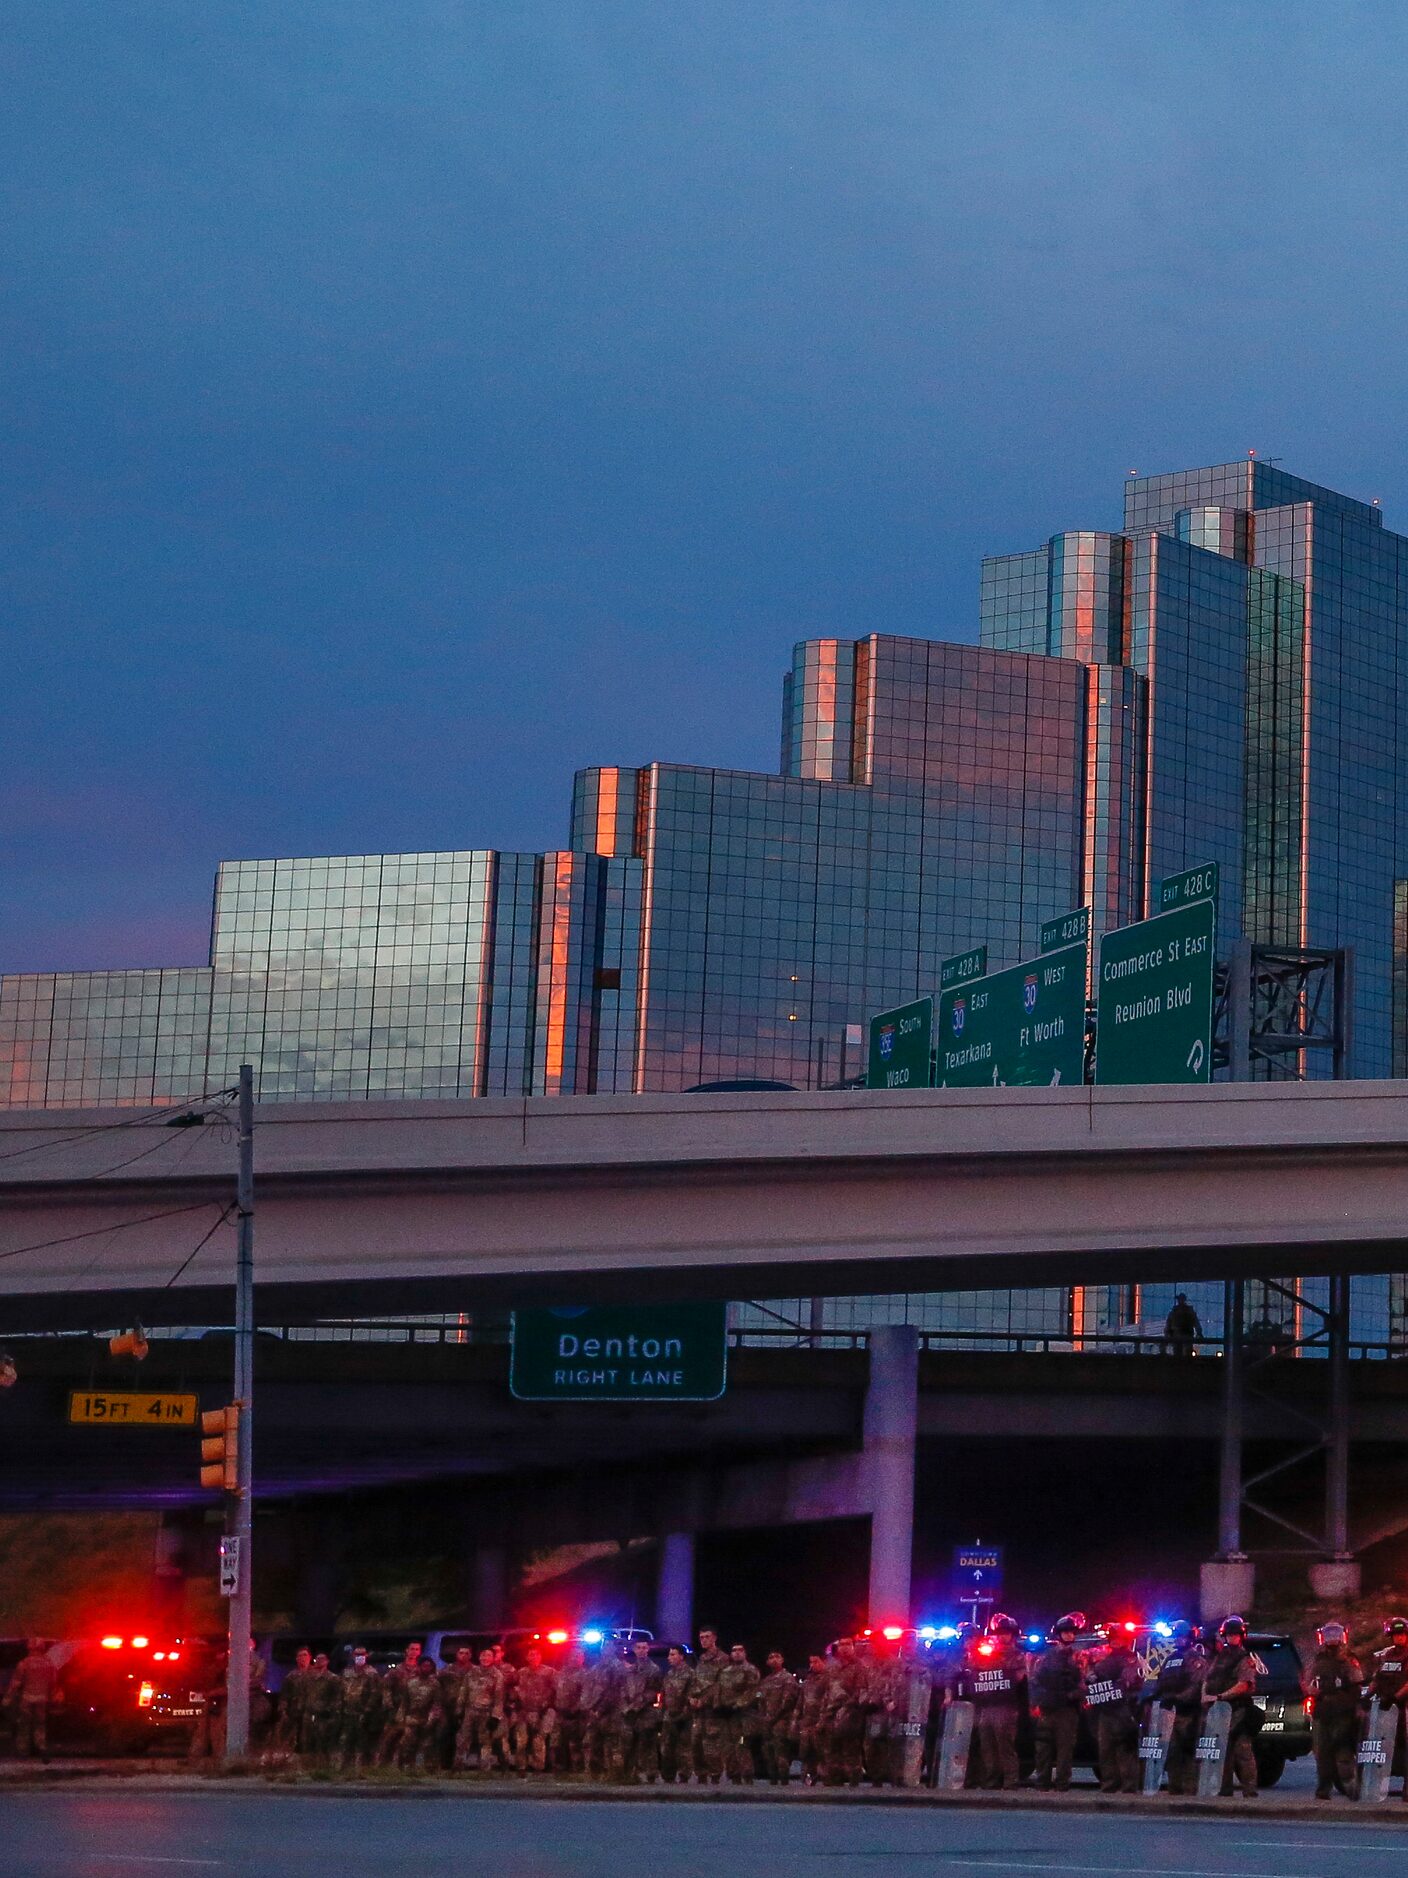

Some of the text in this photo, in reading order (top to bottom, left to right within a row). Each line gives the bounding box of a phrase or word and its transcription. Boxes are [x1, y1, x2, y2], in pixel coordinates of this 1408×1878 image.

[1164, 885, 1178, 902] EXIT
[1044, 929, 1056, 944] EXIT
[1104, 949, 1162, 982] Commerce
[1168, 939, 1180, 963] St
[943, 967, 954, 981] EXIT
[1024, 984, 1036, 1006] 30
[1115, 982, 1192, 1024] Reunion Blvd
[953, 1008, 964, 1030] 30
[1020, 1016, 1064, 1047] Ft Worth
[946, 1042, 992, 1070] Texarkana
[886, 1068, 910, 1088] Waco
[560, 1334, 682, 1358] Denton
[554, 1370, 683, 1385] RIGHT LANE
[960, 1558, 998, 1566] DALLAS
[978, 1670, 1004, 1681] STATE
[974, 1680, 1010, 1692] TROOPER
[1088, 1680, 1114, 1694] STATE
[1086, 1689, 1122, 1705] TROOPER
[1142, 1736, 1160, 1748] STATE
[1198, 1737, 1218, 1748] STATE
[1362, 1740, 1382, 1752] STATE
